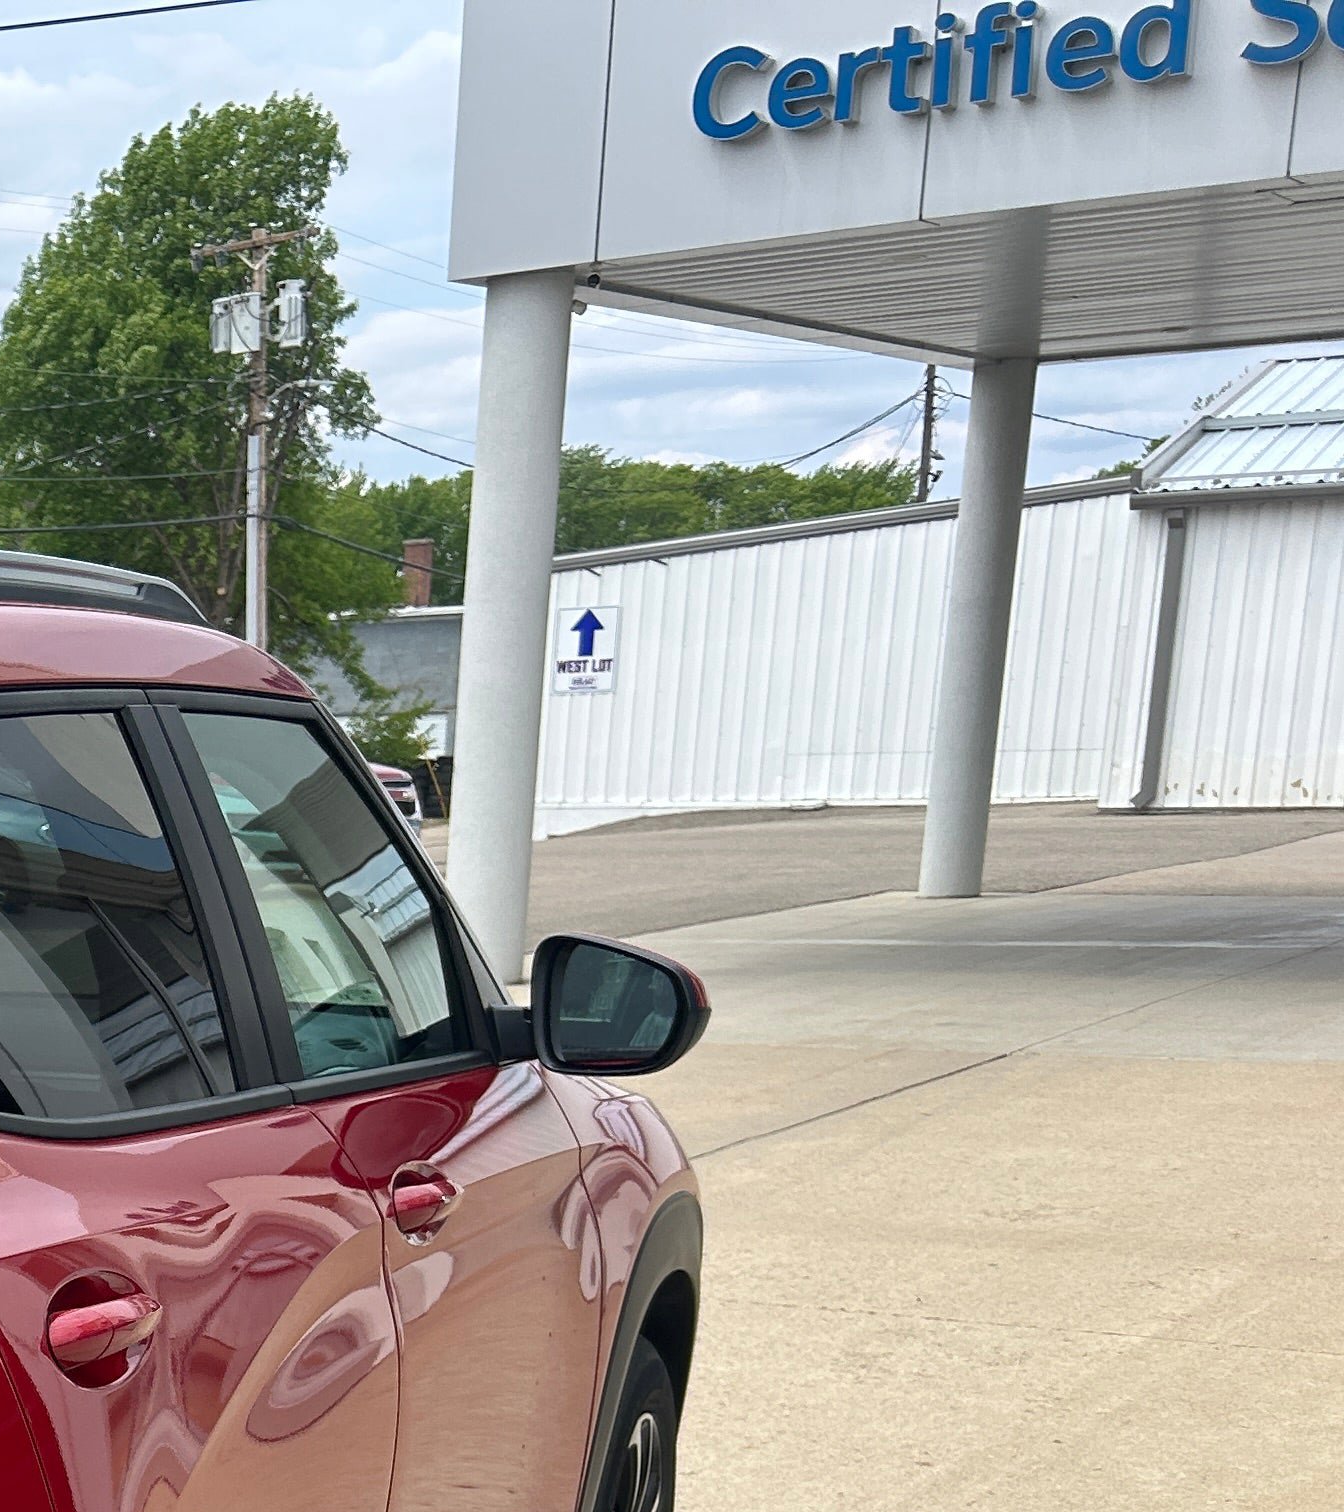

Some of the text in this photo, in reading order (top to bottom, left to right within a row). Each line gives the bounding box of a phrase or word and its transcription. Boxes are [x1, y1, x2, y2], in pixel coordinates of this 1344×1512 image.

[693, 0, 1194, 142] Certified
[557, 658, 613, 674] WEST LOT
